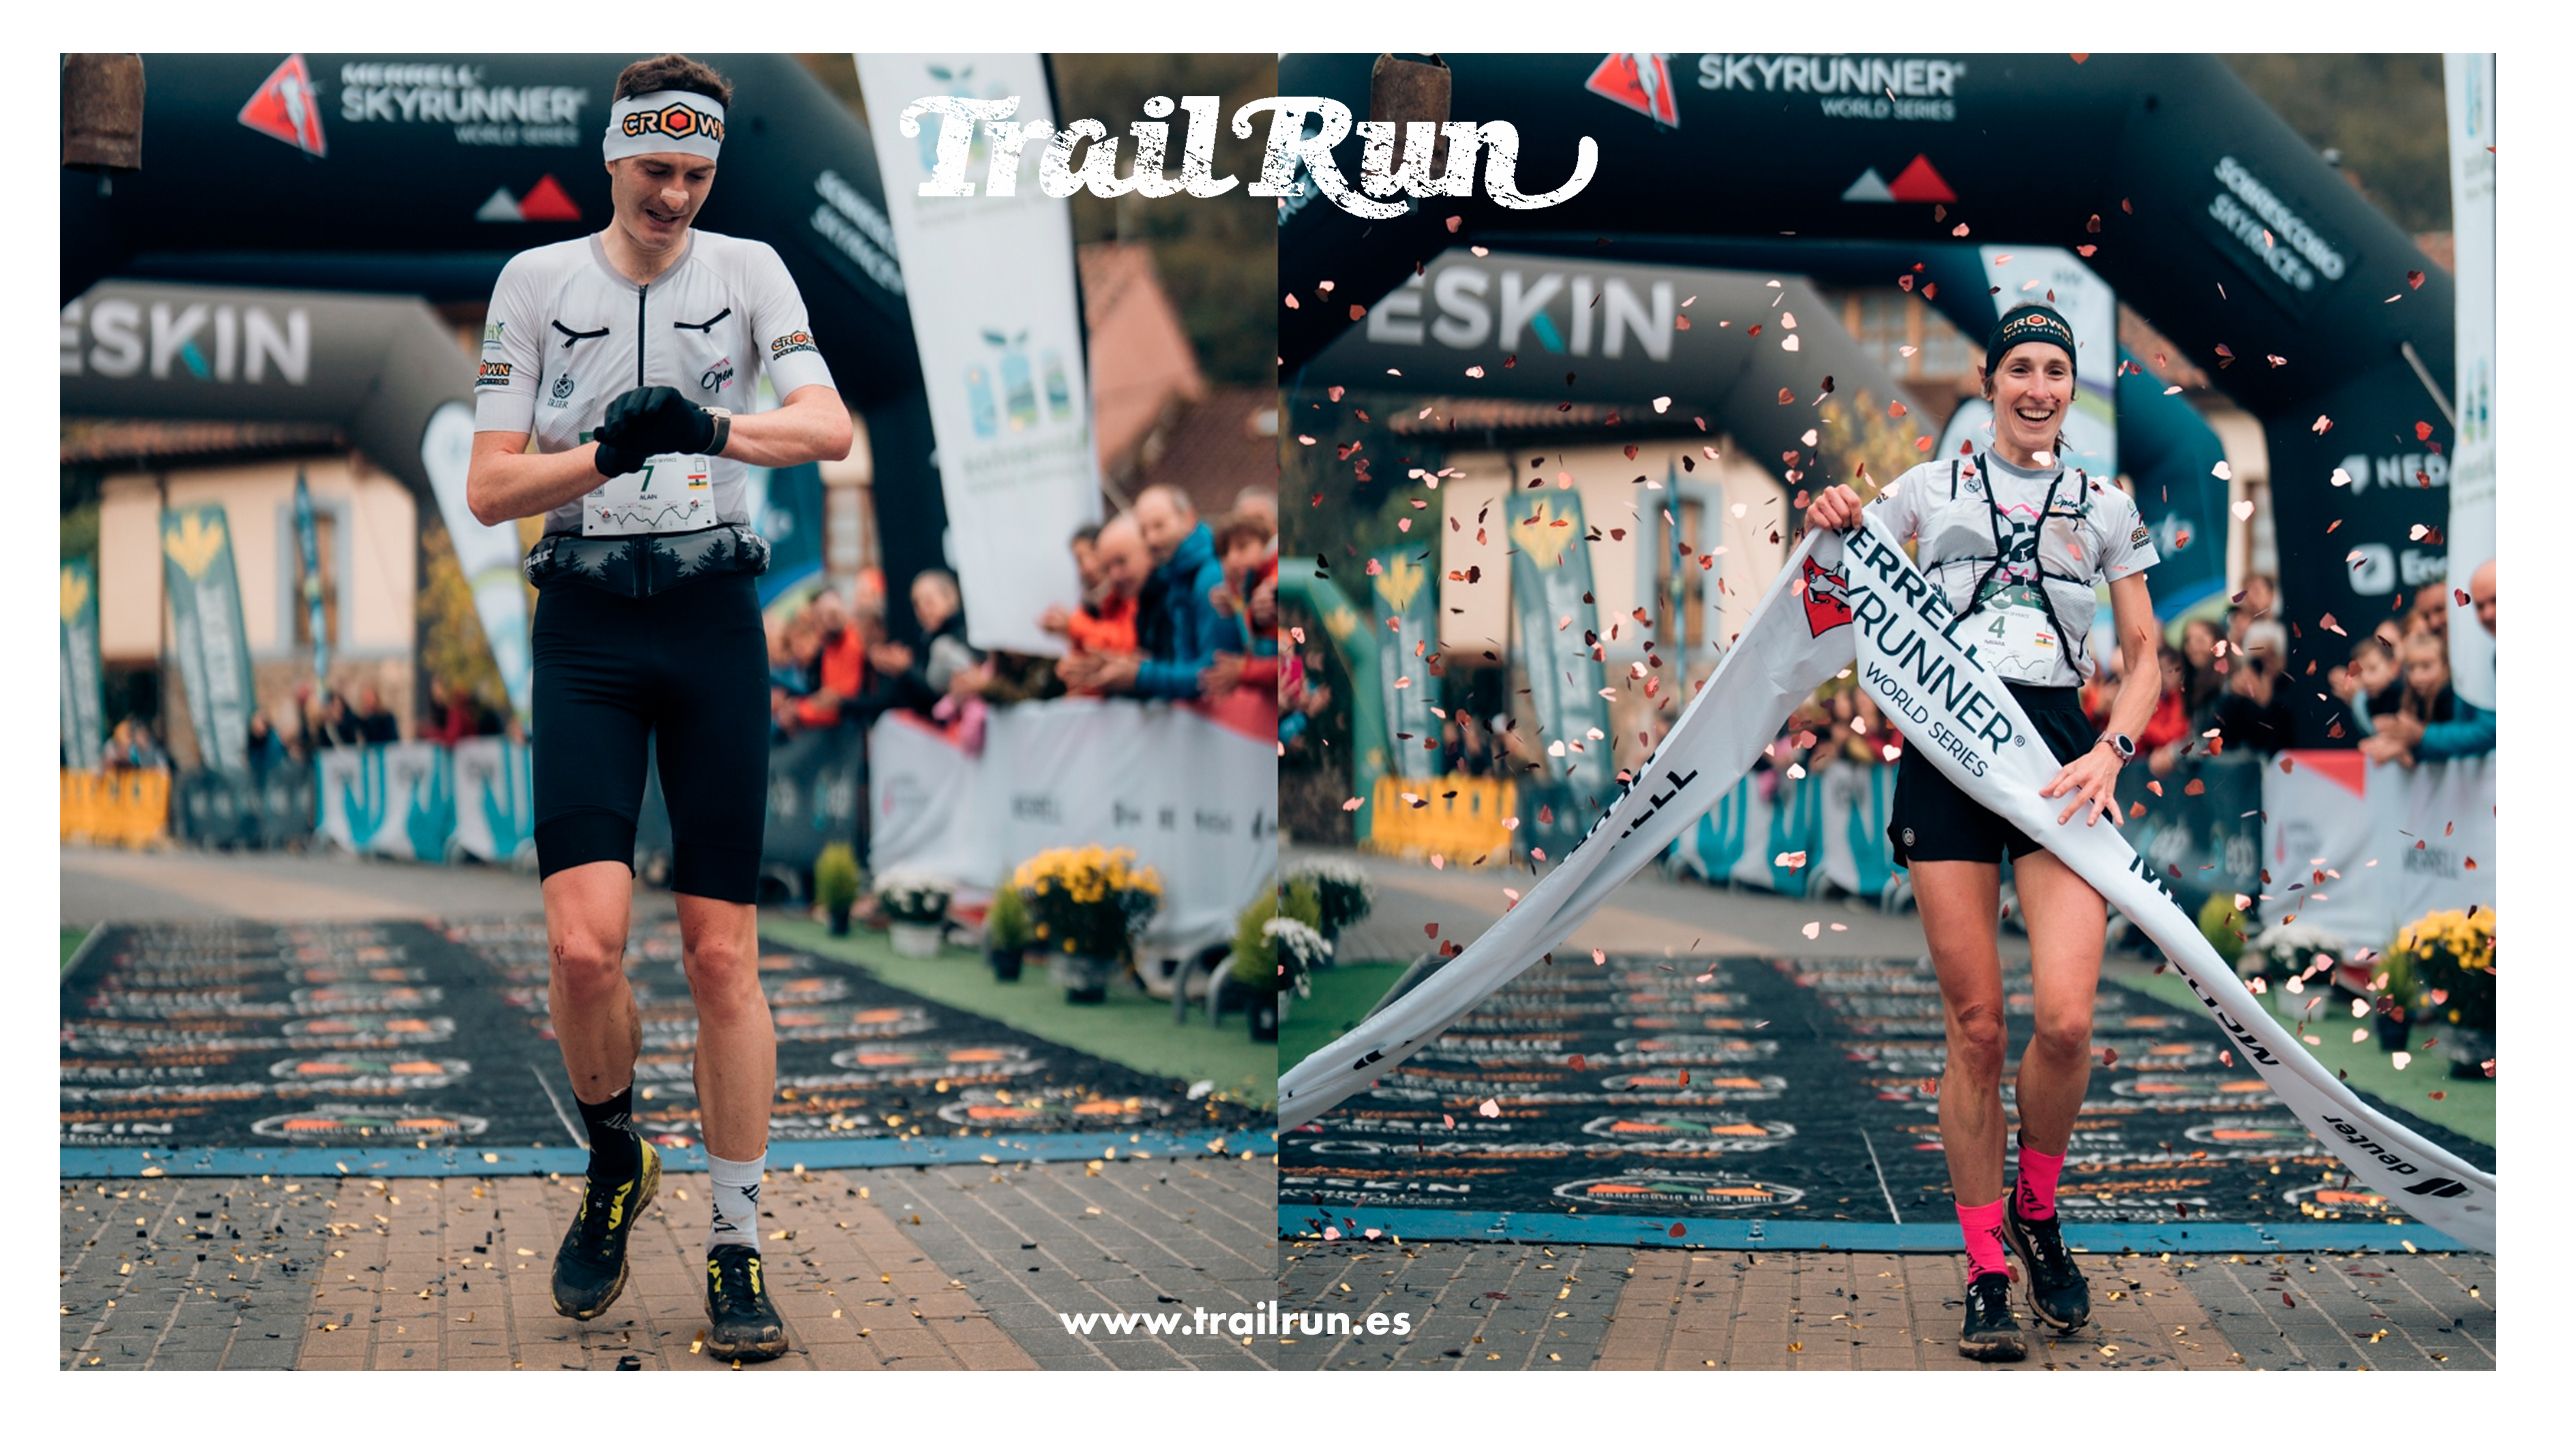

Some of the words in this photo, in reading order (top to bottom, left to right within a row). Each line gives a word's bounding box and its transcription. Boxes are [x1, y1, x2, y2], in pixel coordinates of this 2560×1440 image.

[341, 85, 579, 122] SKYRUNNER
[640, 465, 655, 492] 7
[1846, 526, 1986, 673] ERRELL
[1988, 615, 2006, 639] 4
[1866, 661, 1929, 725] WORLD
[1927, 721, 1989, 778] SERIES
[2321, 1114, 2419, 1176] deuter
